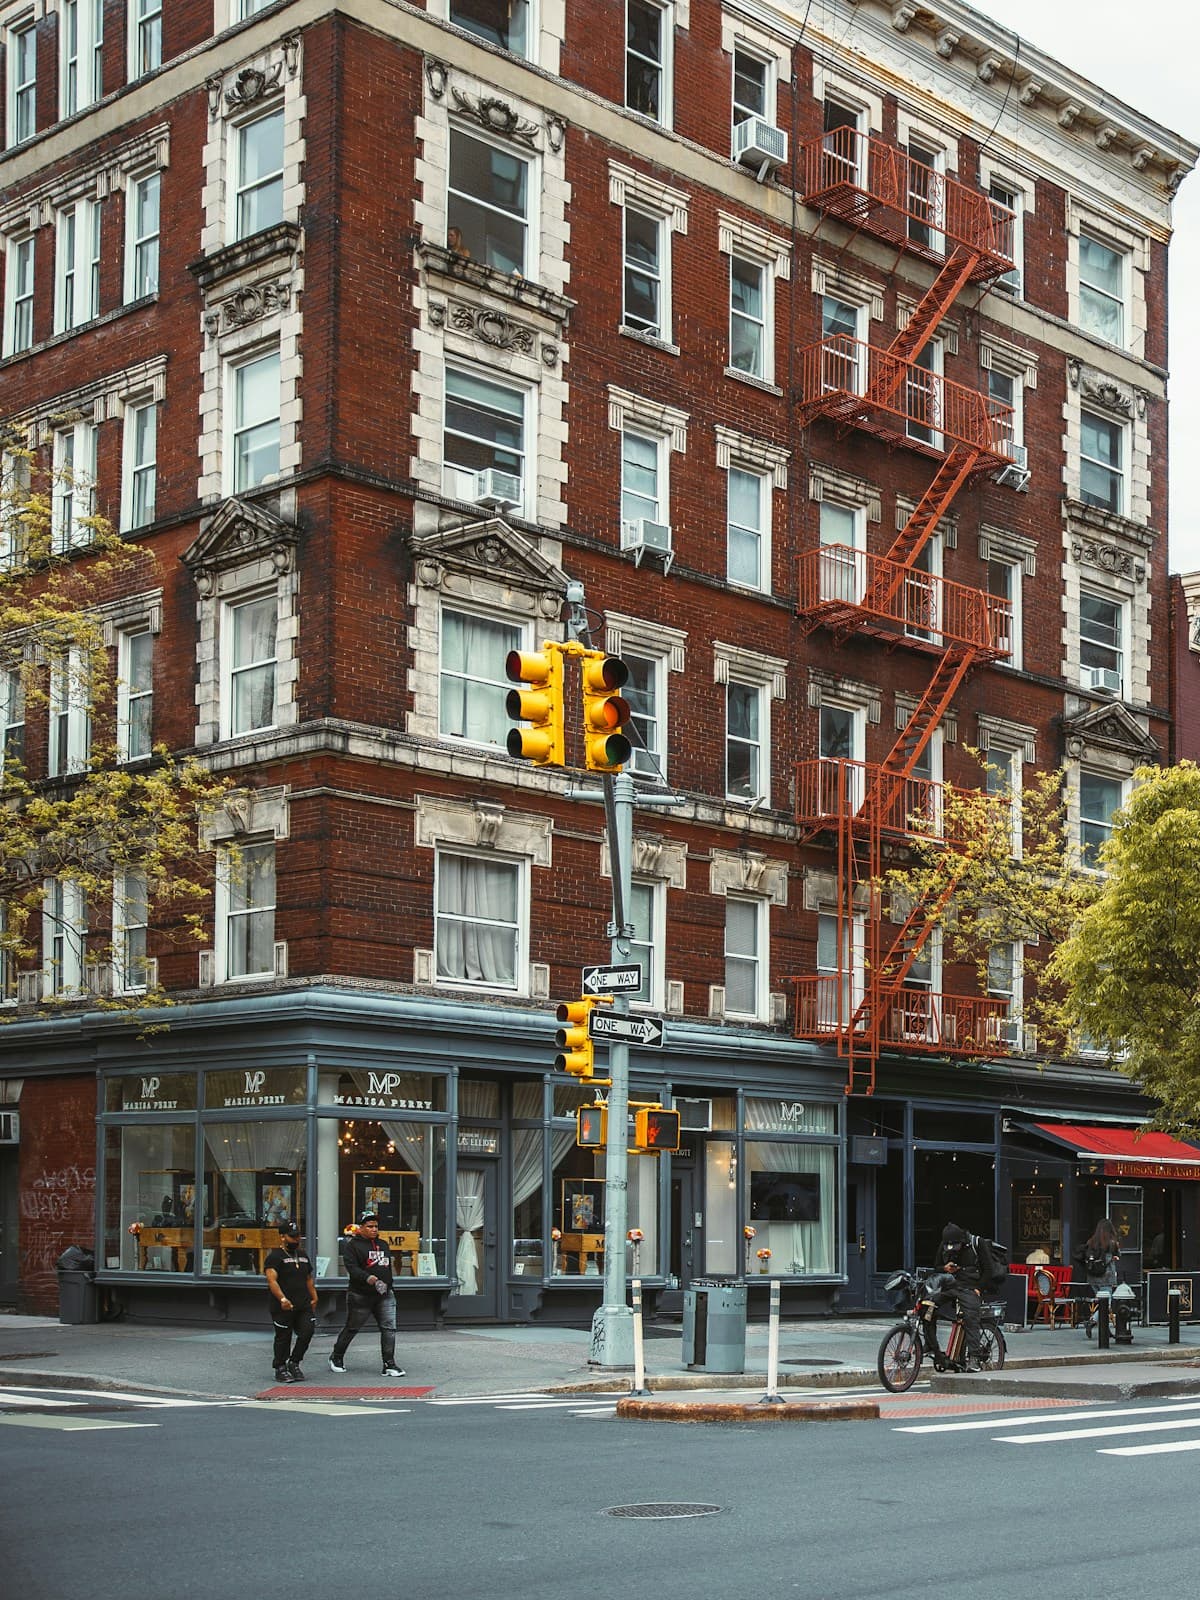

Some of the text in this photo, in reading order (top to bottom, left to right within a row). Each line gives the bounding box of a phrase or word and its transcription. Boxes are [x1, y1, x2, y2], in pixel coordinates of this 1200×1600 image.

[590, 973, 636, 986] ONE WAY
[595, 1018, 653, 1036] ONE WAY
[141, 1077, 160, 1098] MP
[244, 1071, 265, 1093] MP
[367, 1072, 400, 1094] MP
[224, 1096, 285, 1106] MARISA PERRY
[333, 1095, 432, 1109] MARISA PERRY
[780, 1102, 804, 1121] MP
[1117, 1162, 1152, 1176] HUDSON
[388, 1236, 405, 1247] MP
